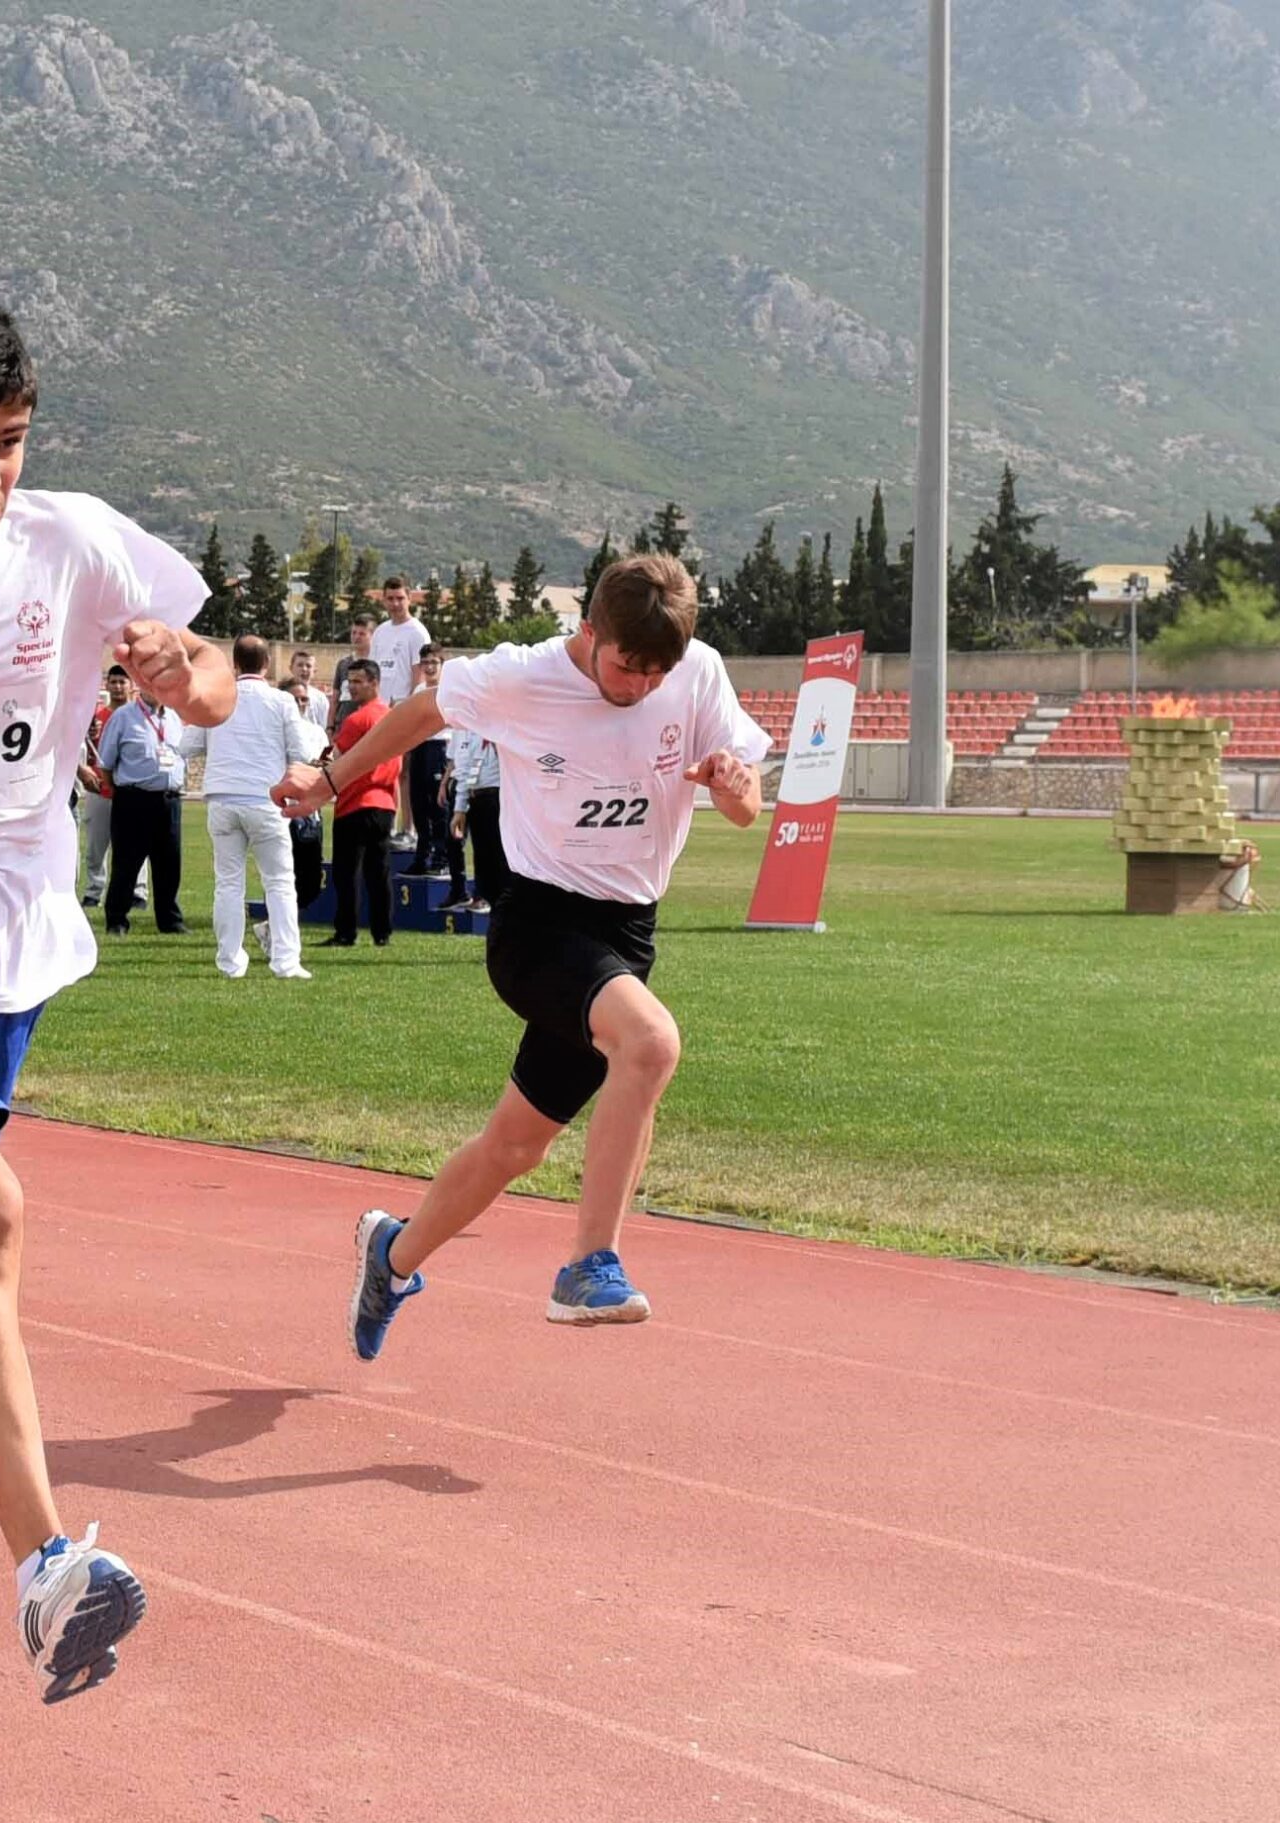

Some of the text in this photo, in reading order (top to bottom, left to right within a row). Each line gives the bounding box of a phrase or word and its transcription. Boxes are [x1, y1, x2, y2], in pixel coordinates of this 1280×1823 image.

[16, 637, 54, 654] Special
[575, 797, 649, 828] 222
[774, 821, 800, 847] 50
[400, 884, 410, 906] 3
